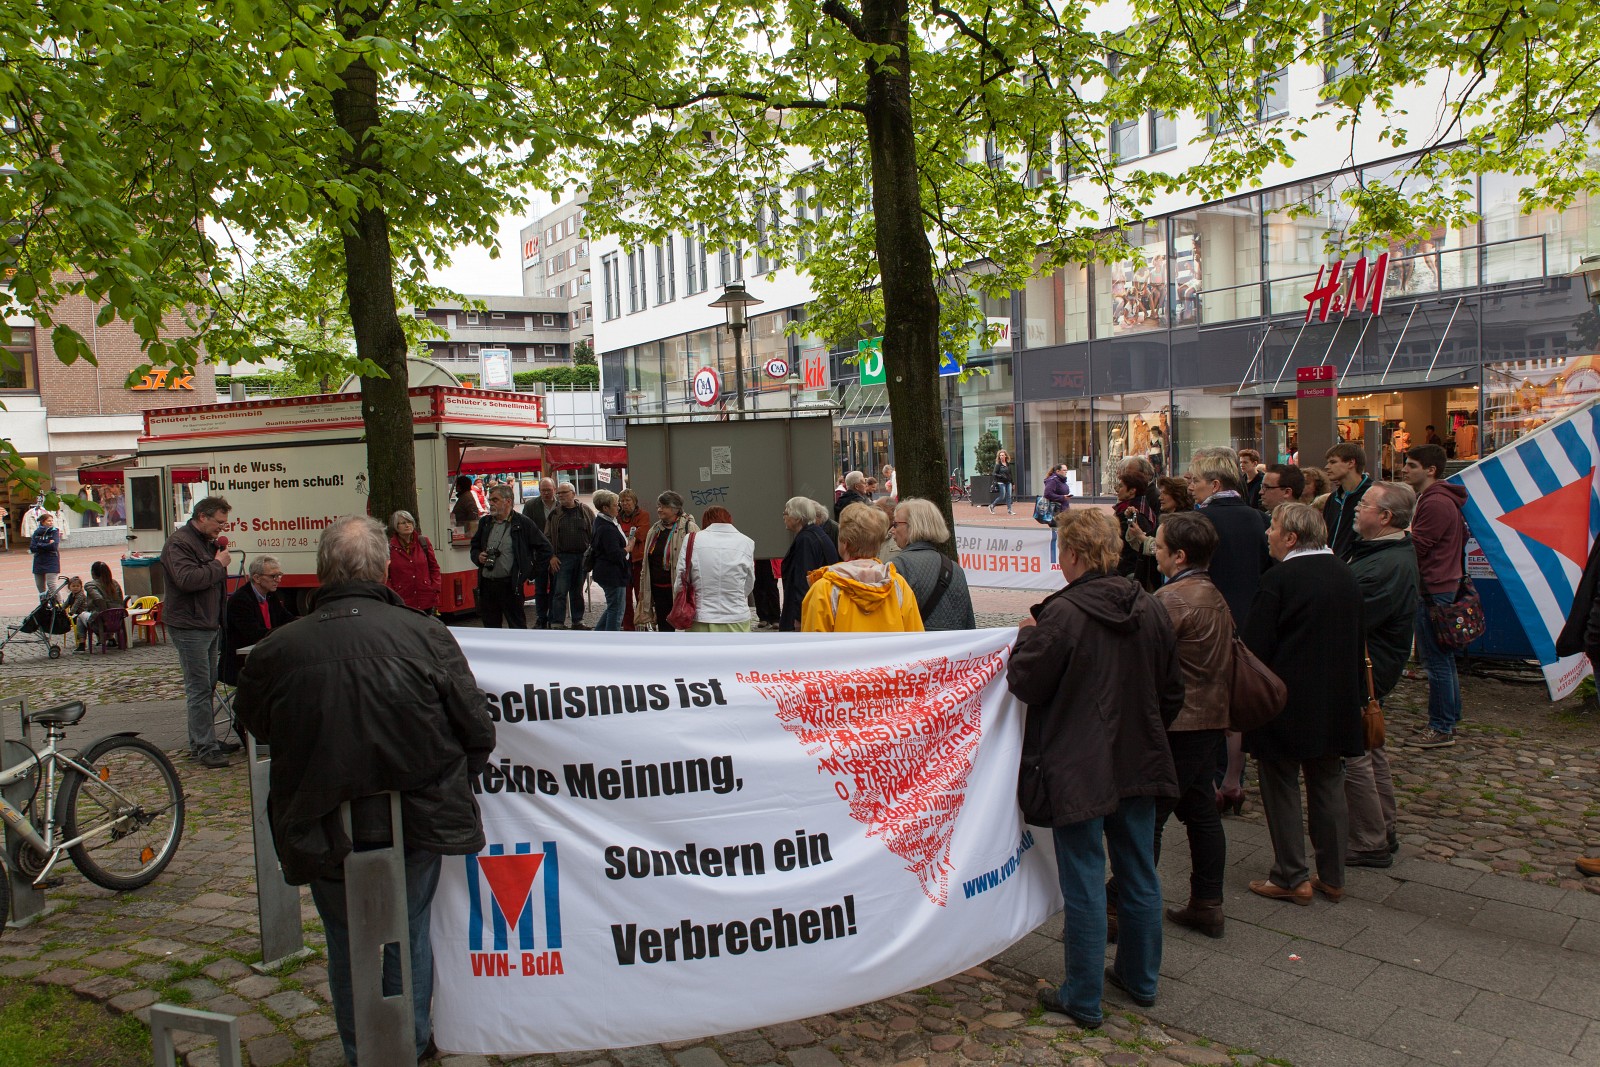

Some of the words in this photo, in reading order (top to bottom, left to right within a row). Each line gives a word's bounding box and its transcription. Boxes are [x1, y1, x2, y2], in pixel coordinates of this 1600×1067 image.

[1303, 252, 1390, 323] H&M
[770, 363, 785, 373] C&A
[805, 356, 826, 388] kik
[696, 377, 714, 396] C&A
[1303, 388, 1325, 396] HotSpot
[446, 397, 487, 406] Schlüter's
[150, 414, 197, 425] Schlüter's
[200, 410, 263, 420] Schnellimbiß
[220, 463, 230, 474] in
[234, 463, 247, 473] de
[251, 461, 286, 473] Wuss,
[210, 480, 225, 491] Du
[229, 479, 270, 492] Hunger
[274, 477, 299, 488] hem
[303, 475, 344, 488] schuß!
[258, 539, 281, 547] 04123
[287, 538, 297, 547] 72
[299, 538, 308, 546] 48
[674, 678, 728, 708] ist
[563, 754, 744, 800] Meinung,
[604, 843, 766, 880] sondern
[773, 829, 834, 872] ein
[610, 894, 858, 966] Verbrechen!
